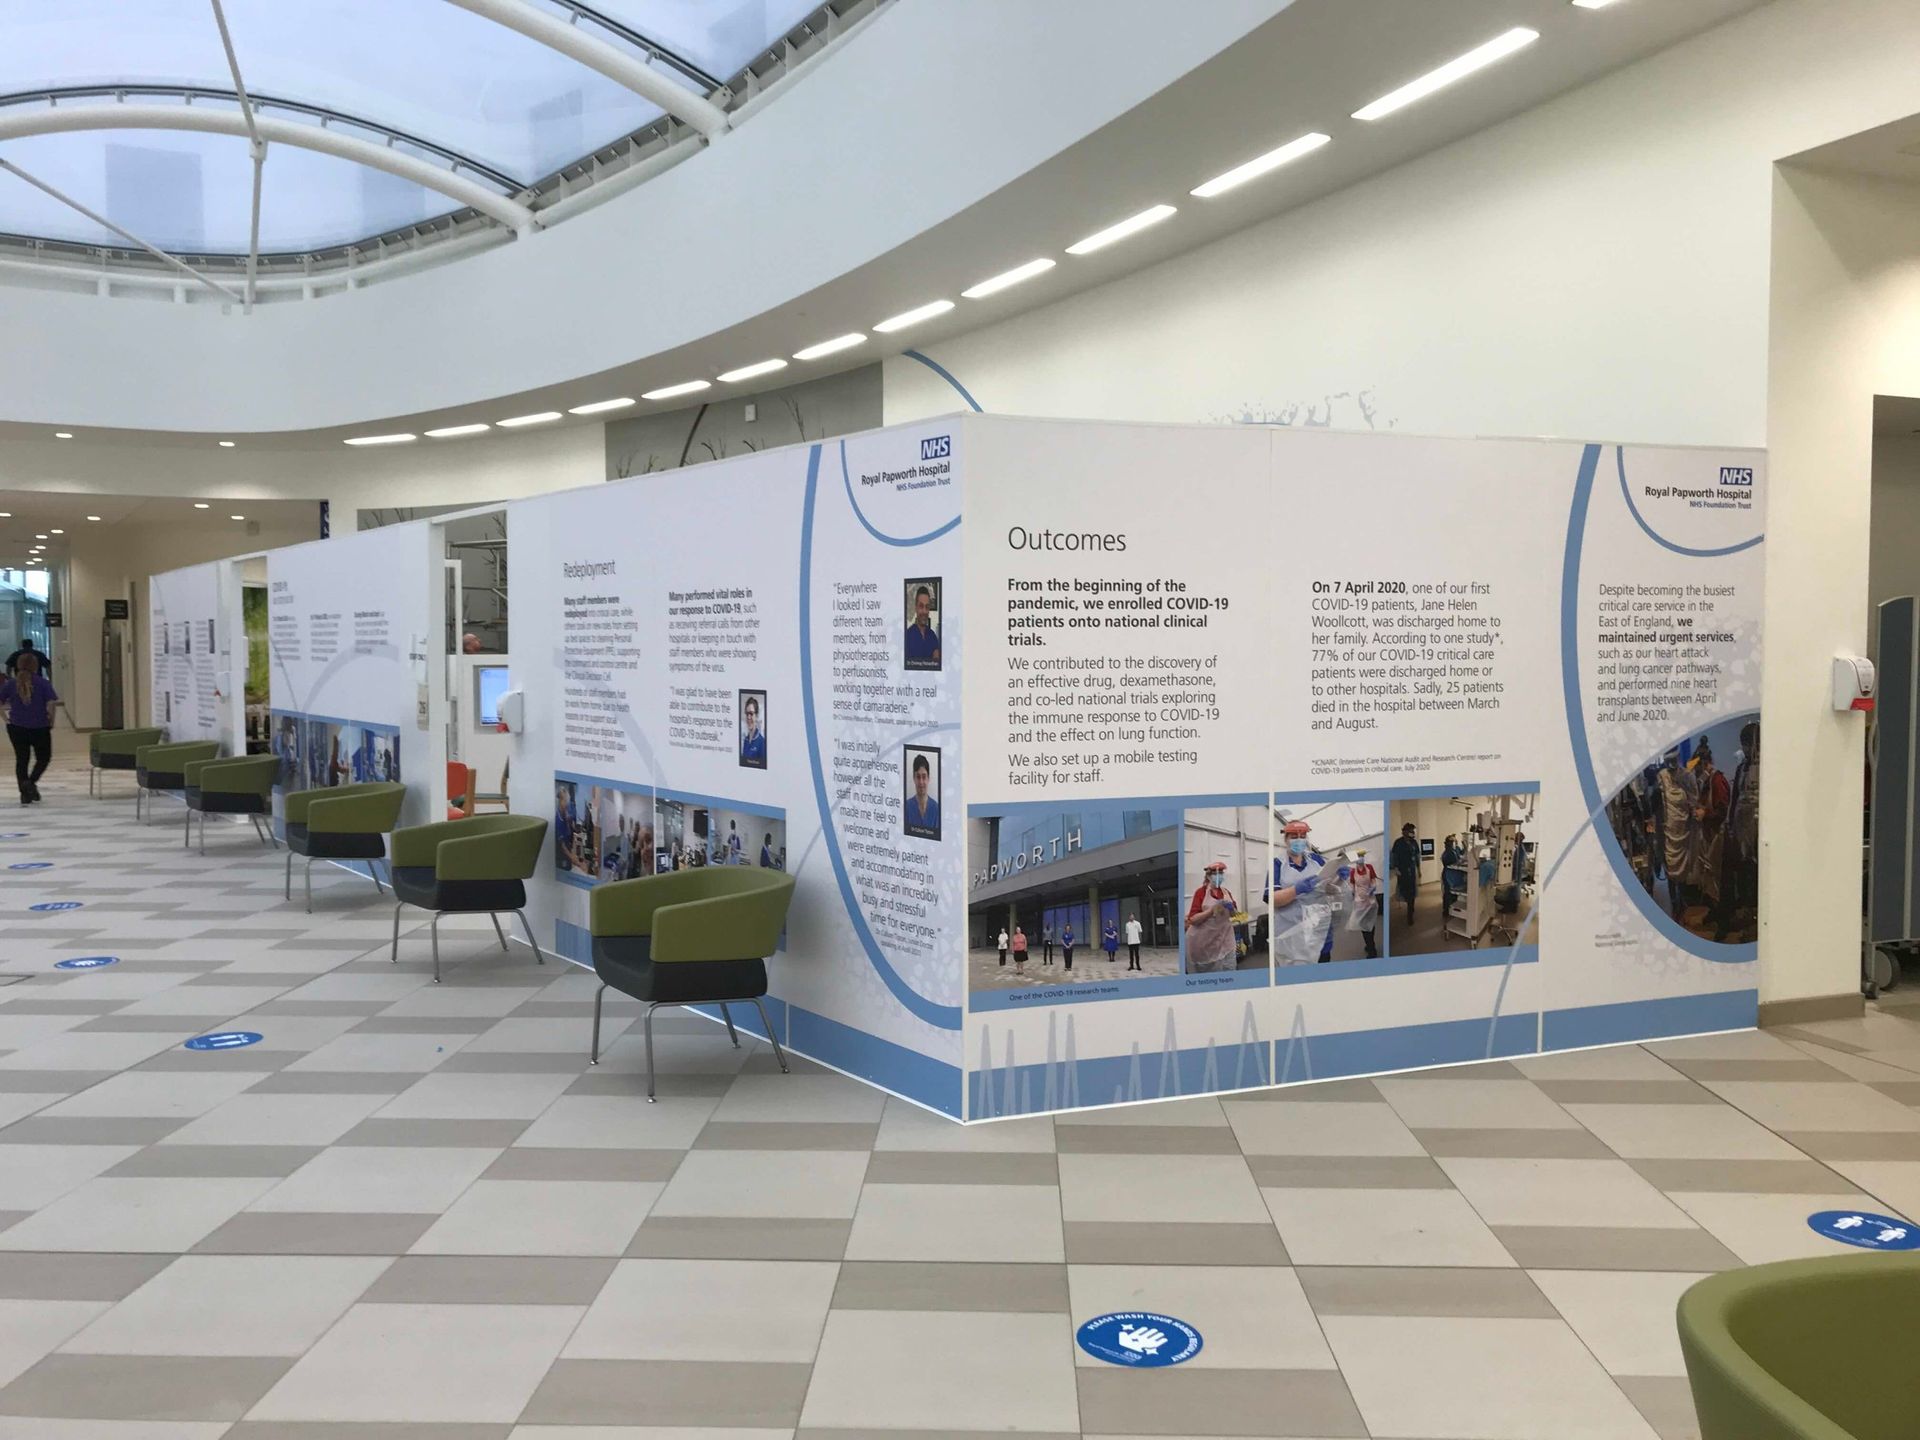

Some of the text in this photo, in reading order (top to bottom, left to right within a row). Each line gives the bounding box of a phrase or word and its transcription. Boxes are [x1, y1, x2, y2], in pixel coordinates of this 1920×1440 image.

[922, 437, 949, 459] NHS
[861, 461, 950, 487] Royal Papworth Hospital
[1722, 469, 1751, 484] NHS
[908, 479, 936, 489] Foundation
[1645, 486, 1751, 500] Royal Papworth Hospital
[1008, 526, 1127, 552] Outcomes
[564, 560, 616, 580] Redeployment
[1008, 579, 1186, 595] From the beginning of the
[1312, 581, 1490, 597] On 7 April 2020, one of our first
[1599, 584, 1735, 597] Despite becoming the busiest
[669, 587, 752, 603] Many performed vital roles in
[669, 603, 757, 616] our response to COVID-19, such
[836, 599, 860, 611] looked
[866, 601, 881, 611] saw
[1008, 597, 1228, 612] pandemic, we enrolled COVID-19
[1312, 599, 1477, 613] COVID-19 patients, Jane Helen
[1599, 600, 1714, 612] critical care service in the
[833, 616, 883, 628] different team
[1008, 615, 1207, 630] patients onto national clinical
[1312, 616, 1501, 630] Woollcott, was discharged home to
[1599, 615, 1693, 629] East of England, we
[1008, 633, 1047, 646] trials.
[1598, 632, 1736, 645] maintained urgent services,
[1008, 655, 1218, 671] We contributed to the discovery of
[1312, 649, 1494, 662] 77% of our COVID-19 critical care
[1008, 673, 1216, 690] an effective drug, dexamethasone,
[1008, 692, 1215, 707] and co-led national trials exploring
[1312, 698, 1500, 714] died in the hospital between March
[1008, 709, 1220, 726] the immune response to COVID-19
[1008, 726, 1201, 743] and the effect on lung function.
[1008, 750, 1197, 768] We also set up a mobile testing
[1366, 756, 1379, 764] Care
[1381, 755, 1403, 763] National
[1009, 770, 1103, 787] facility for staff.
[847, 840, 928, 866] were extremely patient
[973, 828, 1082, 887] PAPWORTH
[851, 857, 934, 885] and accommodating in
[1186, 978, 1196, 986] Our
[1198, 978, 1217, 986] testing
[1009, 993, 1022, 1001] One
[1032, 992, 1042, 1000] the
[1044, 990, 1073, 999] COVID-19
[1074, 988, 1099, 996] research
